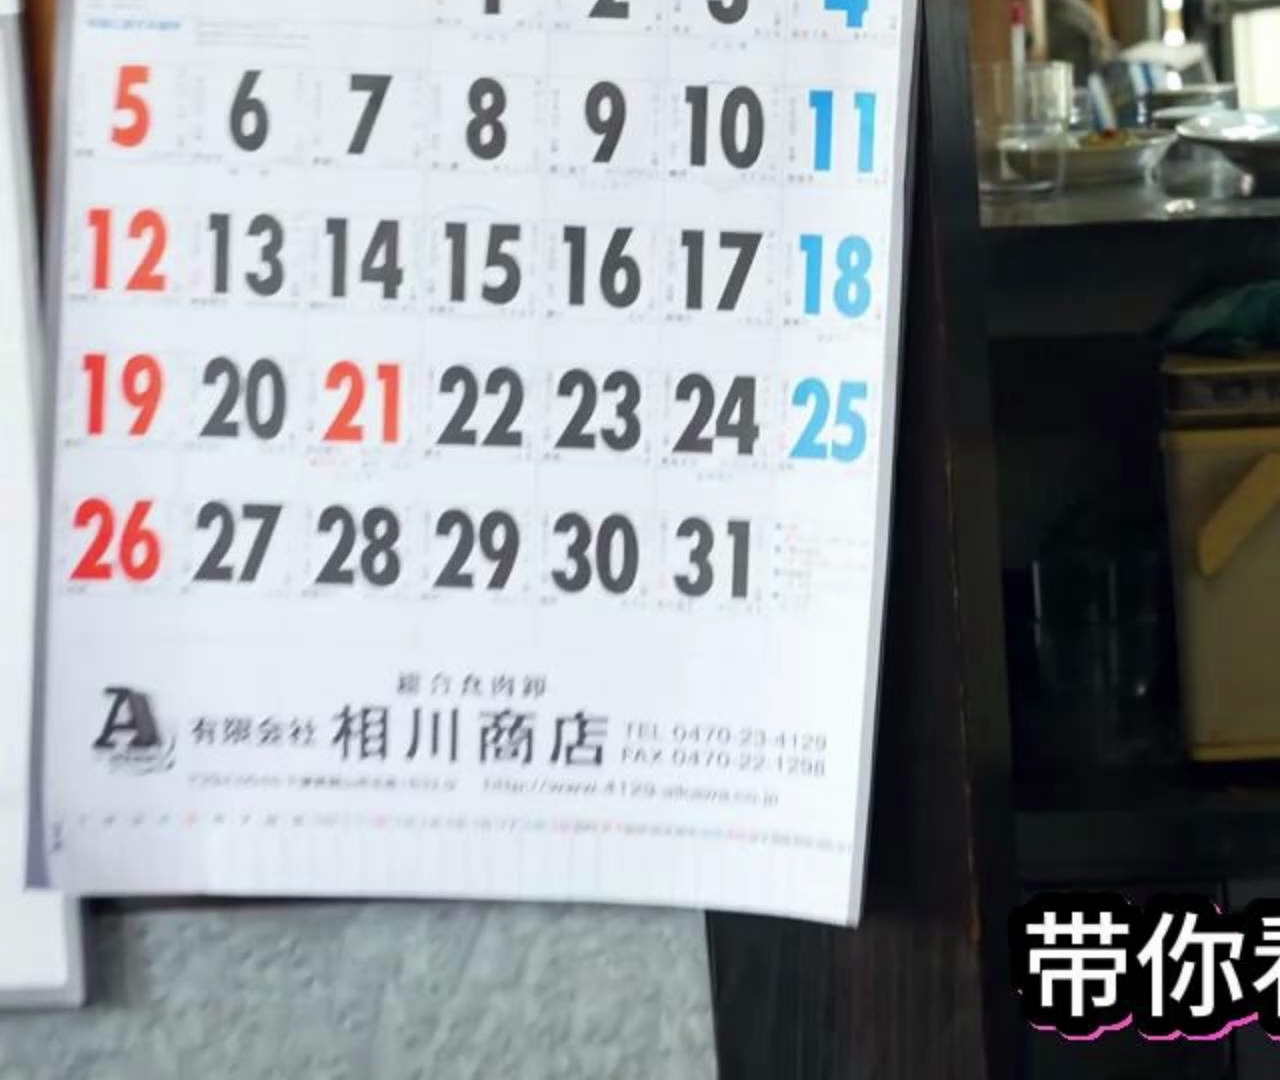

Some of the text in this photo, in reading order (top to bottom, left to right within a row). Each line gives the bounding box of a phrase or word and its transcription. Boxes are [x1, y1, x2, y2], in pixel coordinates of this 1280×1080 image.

[111, 65, 876, 172] 5 6 7 8 9 10 11
[88, 209, 873, 317] 12 13 14 15 16 17 18
[83, 353, 869, 461] 19 20 21 22 23 24 25
[70, 498, 162, 582] 26
[193, 501, 283, 583] 27
[314, 505, 401, 587] 28
[434, 509, 520, 590] 29
[551, 512, 639, 594] 30
[674, 516, 751, 598] 31
[190, 703, 609, 769] 有限会社 相川商店
[620, 748, 665, 766] FAX
[624, 721, 663, 740] TEL
